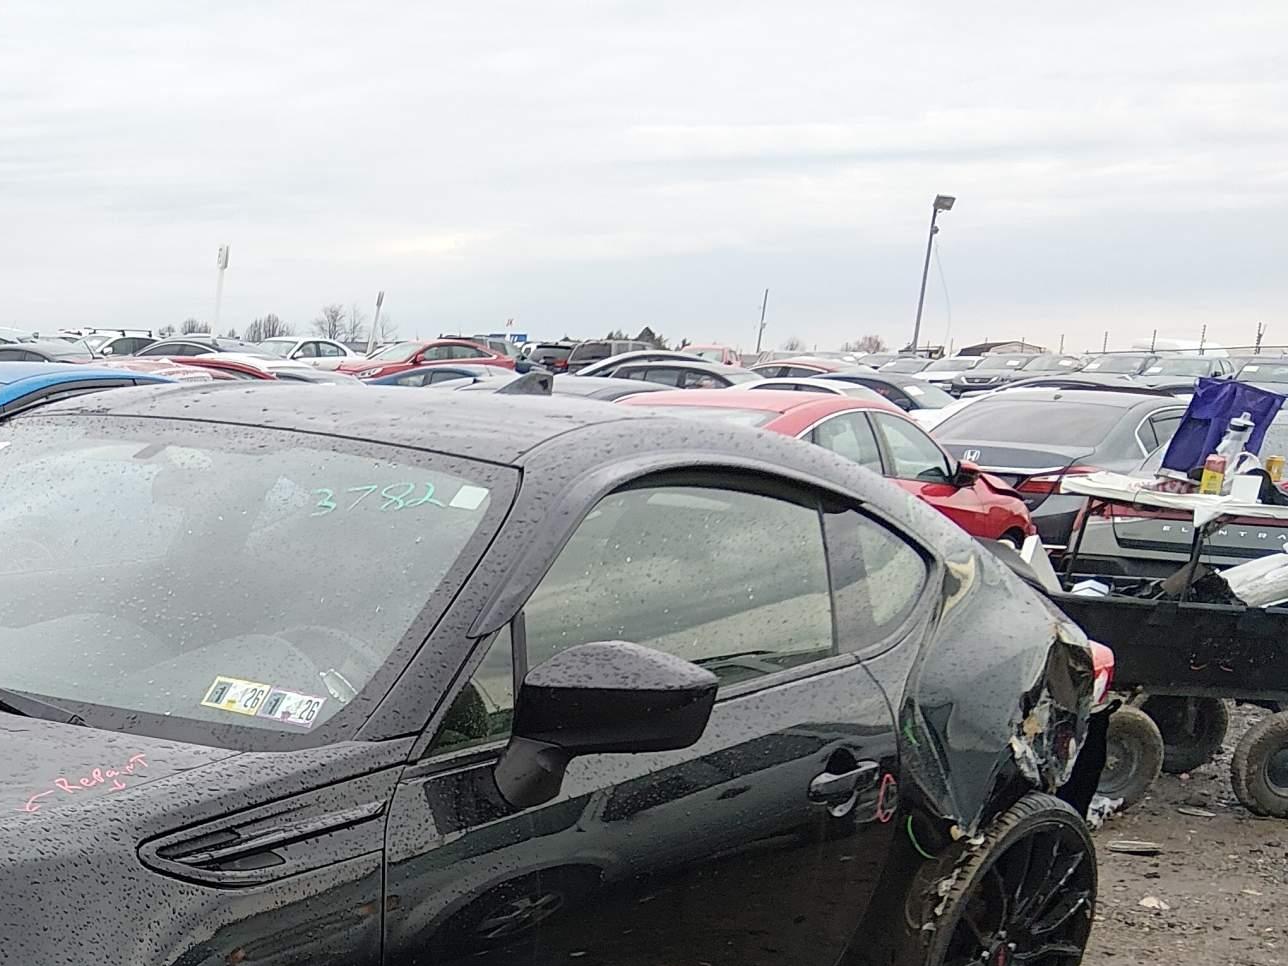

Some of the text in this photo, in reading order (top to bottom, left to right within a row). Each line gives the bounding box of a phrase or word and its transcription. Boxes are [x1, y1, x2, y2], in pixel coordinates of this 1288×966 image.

[311, 482, 447, 517] 3782
[1161, 524, 1287, 541] ELNTRA
[243, 687, 265, 709] 26
[298, 699, 320, 721] 26
